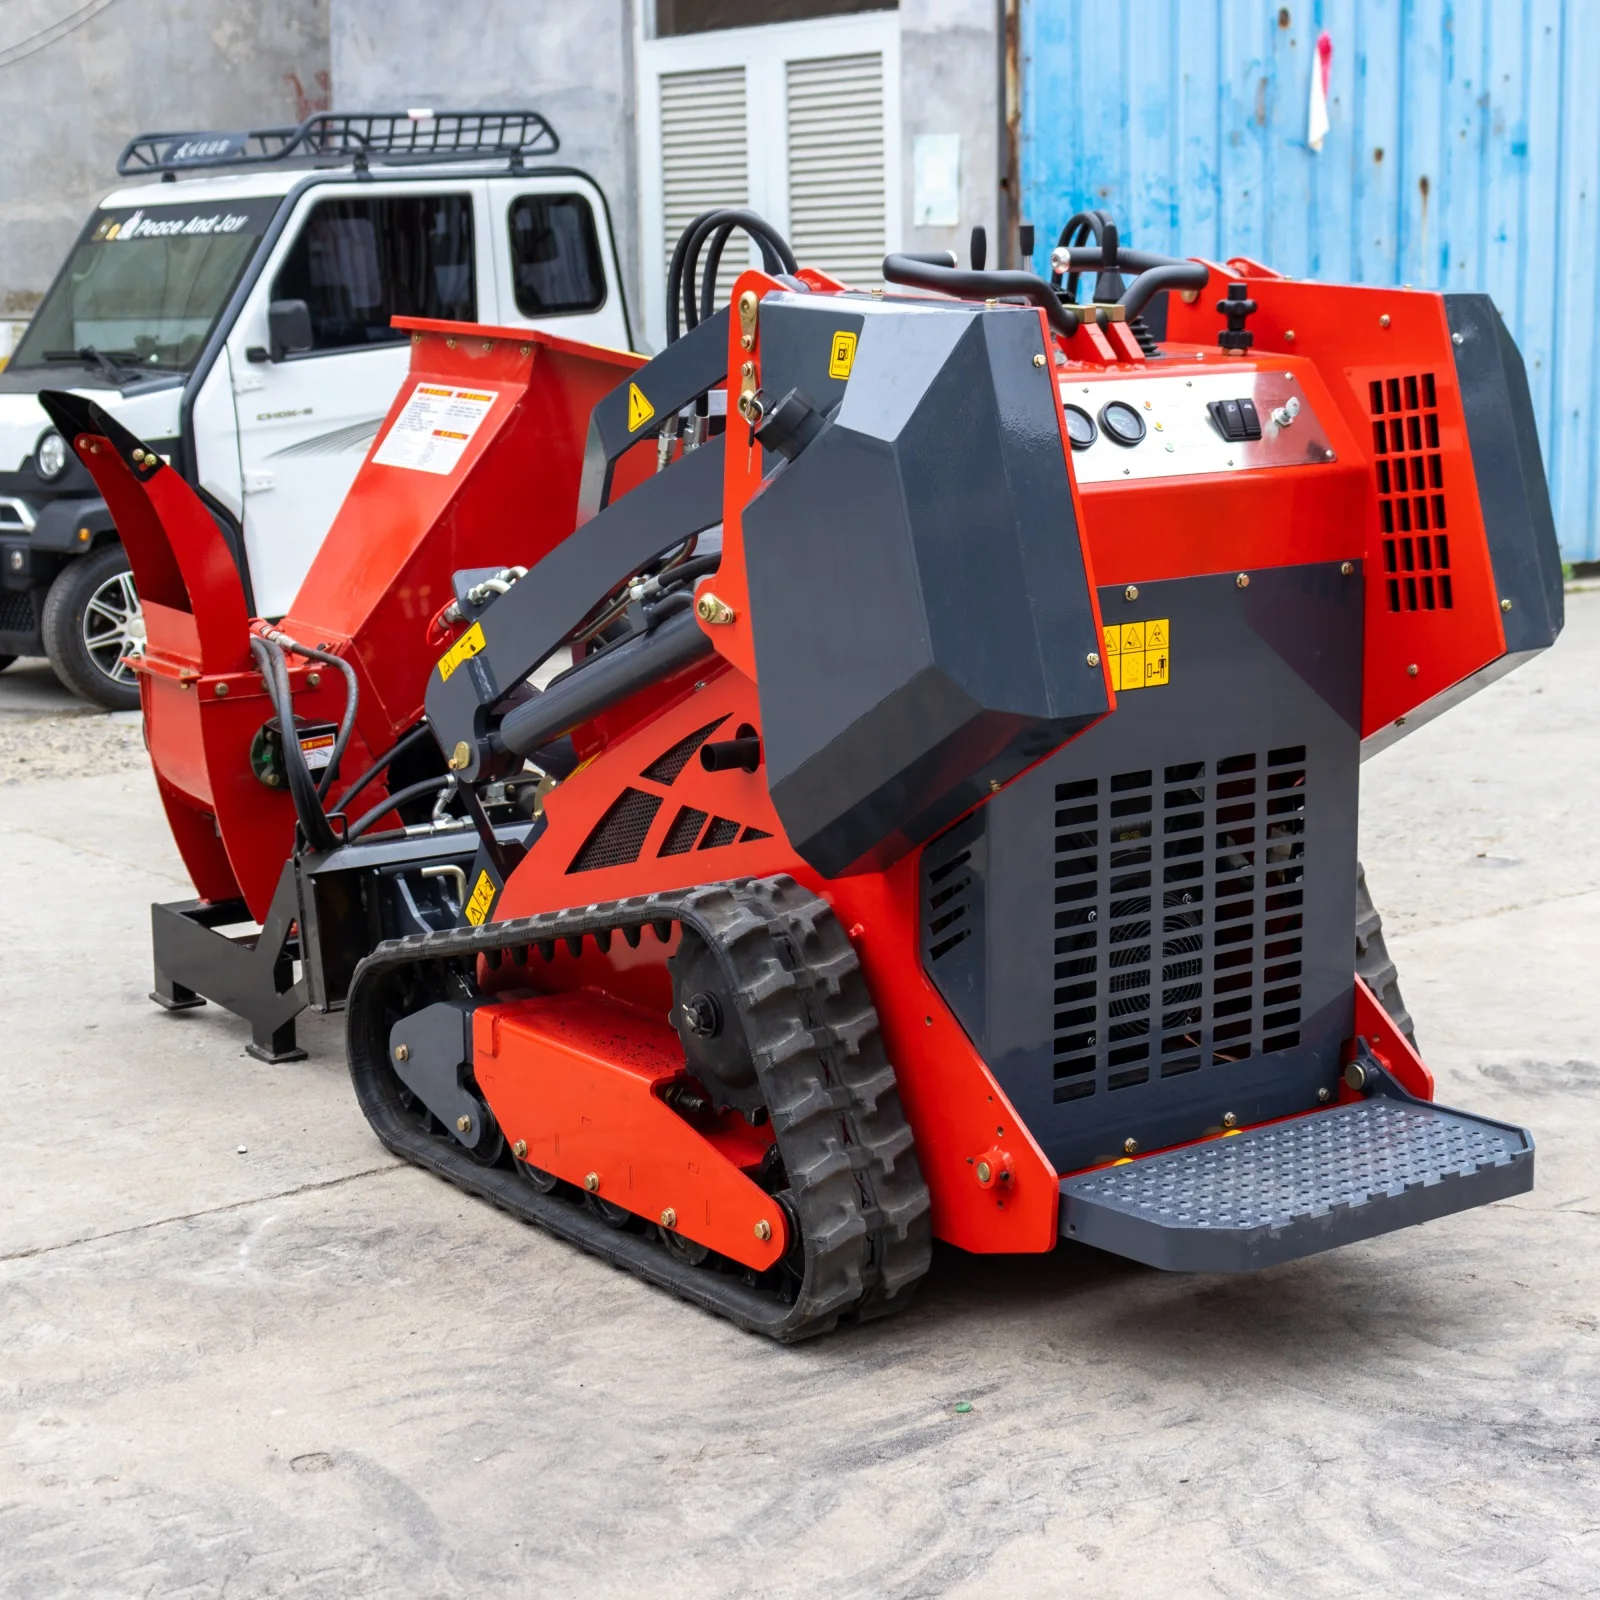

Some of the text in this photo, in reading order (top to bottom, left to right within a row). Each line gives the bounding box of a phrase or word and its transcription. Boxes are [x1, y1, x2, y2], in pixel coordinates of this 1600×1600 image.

[134, 213, 248, 237] Peace And Joy
